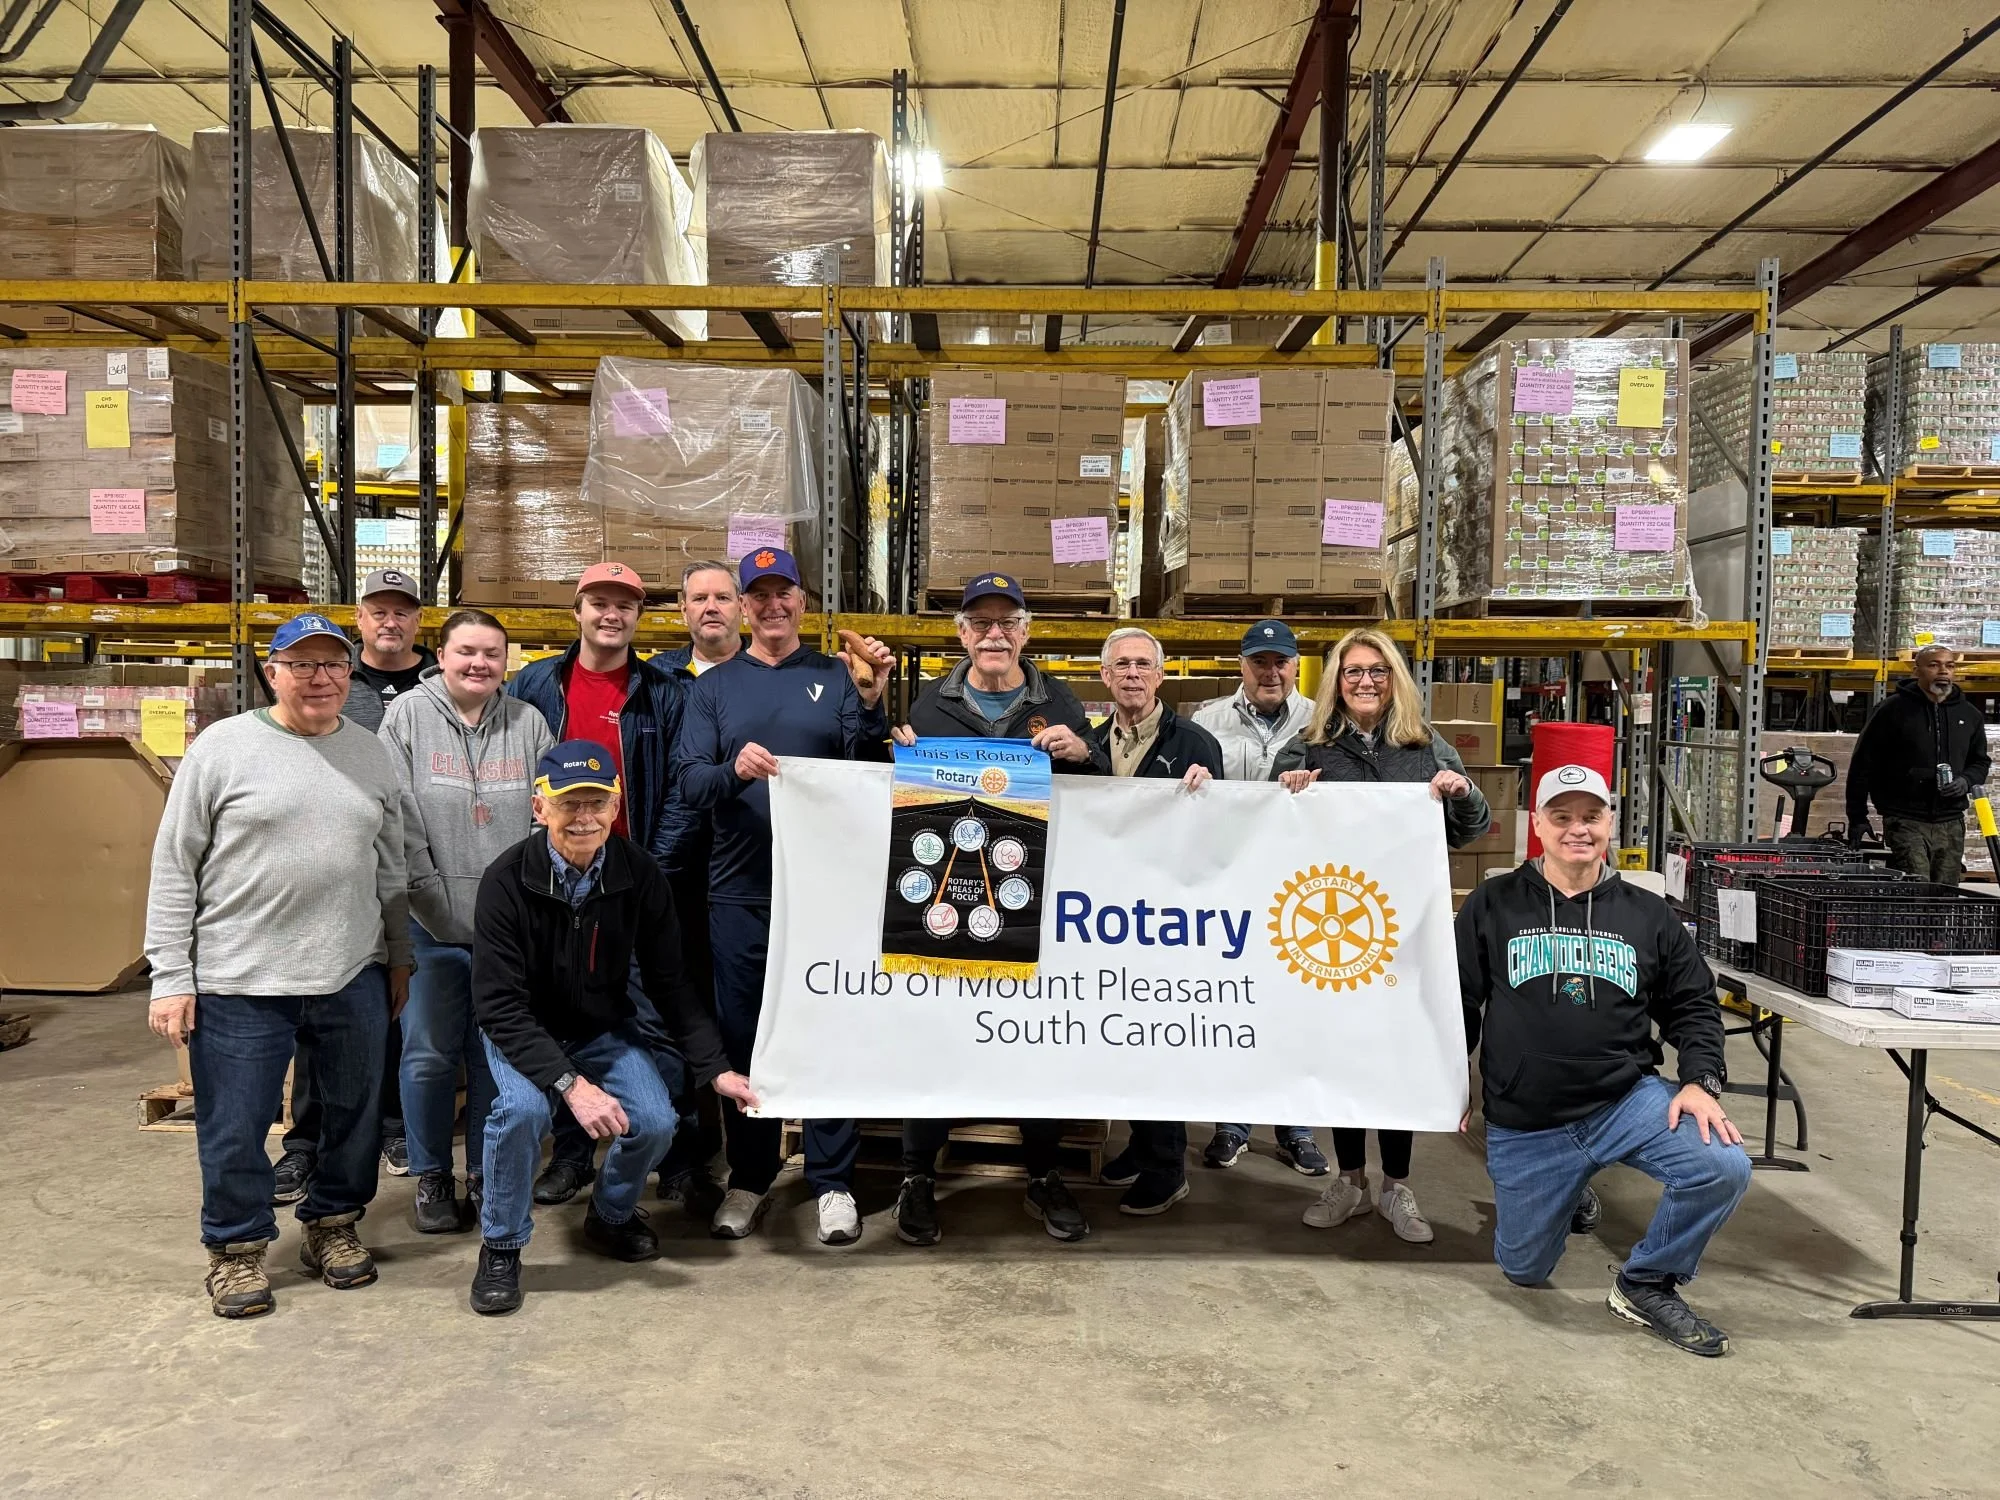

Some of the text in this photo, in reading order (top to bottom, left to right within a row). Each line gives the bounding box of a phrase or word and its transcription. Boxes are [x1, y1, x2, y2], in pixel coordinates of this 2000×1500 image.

[563, 761, 588, 769] Rotary
[912, 749, 1033, 766] This is Rotary
[936, 768, 978, 787] Rotary
[946, 885, 974, 895] AREAS
[974, 886, 985, 895] OF
[947, 877, 985, 888] ROTARY'S
[1304, 877, 1358, 893] ROTARY
[952, 893, 979, 902] FOCUS
[1056, 890, 1252, 960] Rotary
[1519, 926, 1625, 941] COASTAL CAROLINA UIVERSITY
[1290, 946, 1381, 978] INTERNATIONAL
[1508, 933, 1638, 999] CHANTICLEERS
[804, 960, 894, 997] Club
[958, 972, 1085, 1001] Mount
[1098, 969, 1256, 1005] Pleasant
[1914, 997, 1935, 1005] ULINE
[975, 1010, 1256, 1049] South Carolina
